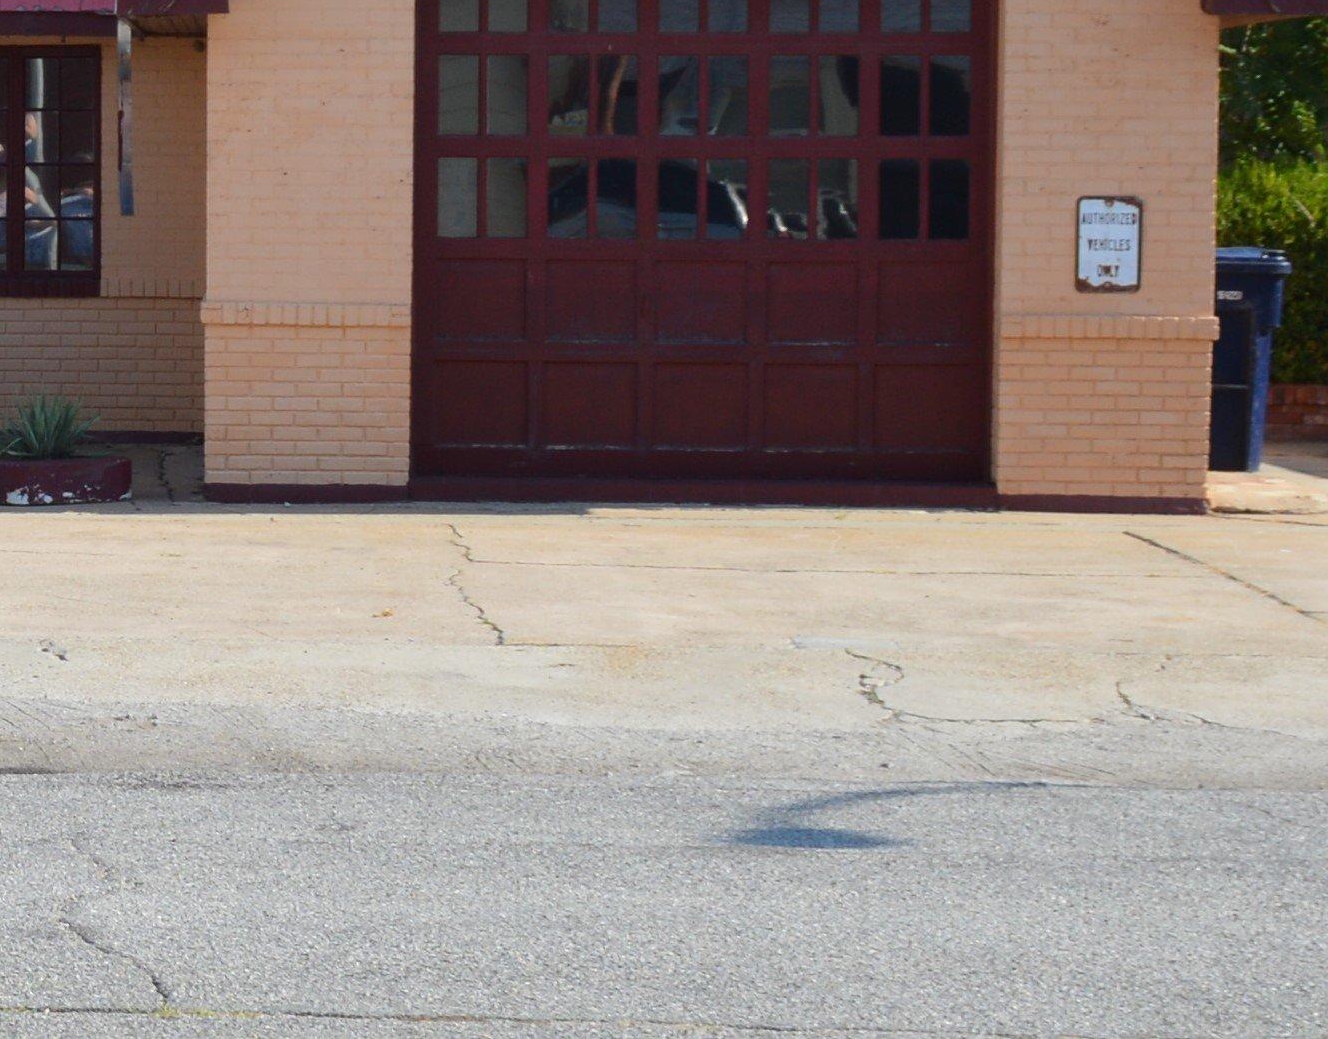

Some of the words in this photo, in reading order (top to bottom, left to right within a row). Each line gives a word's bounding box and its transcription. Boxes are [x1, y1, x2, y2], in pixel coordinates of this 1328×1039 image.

[1081, 212, 1137, 225] AUTHORIZED
[1087, 239, 1131, 251] VEHICLES
[1097, 264, 1120, 277] OLY
